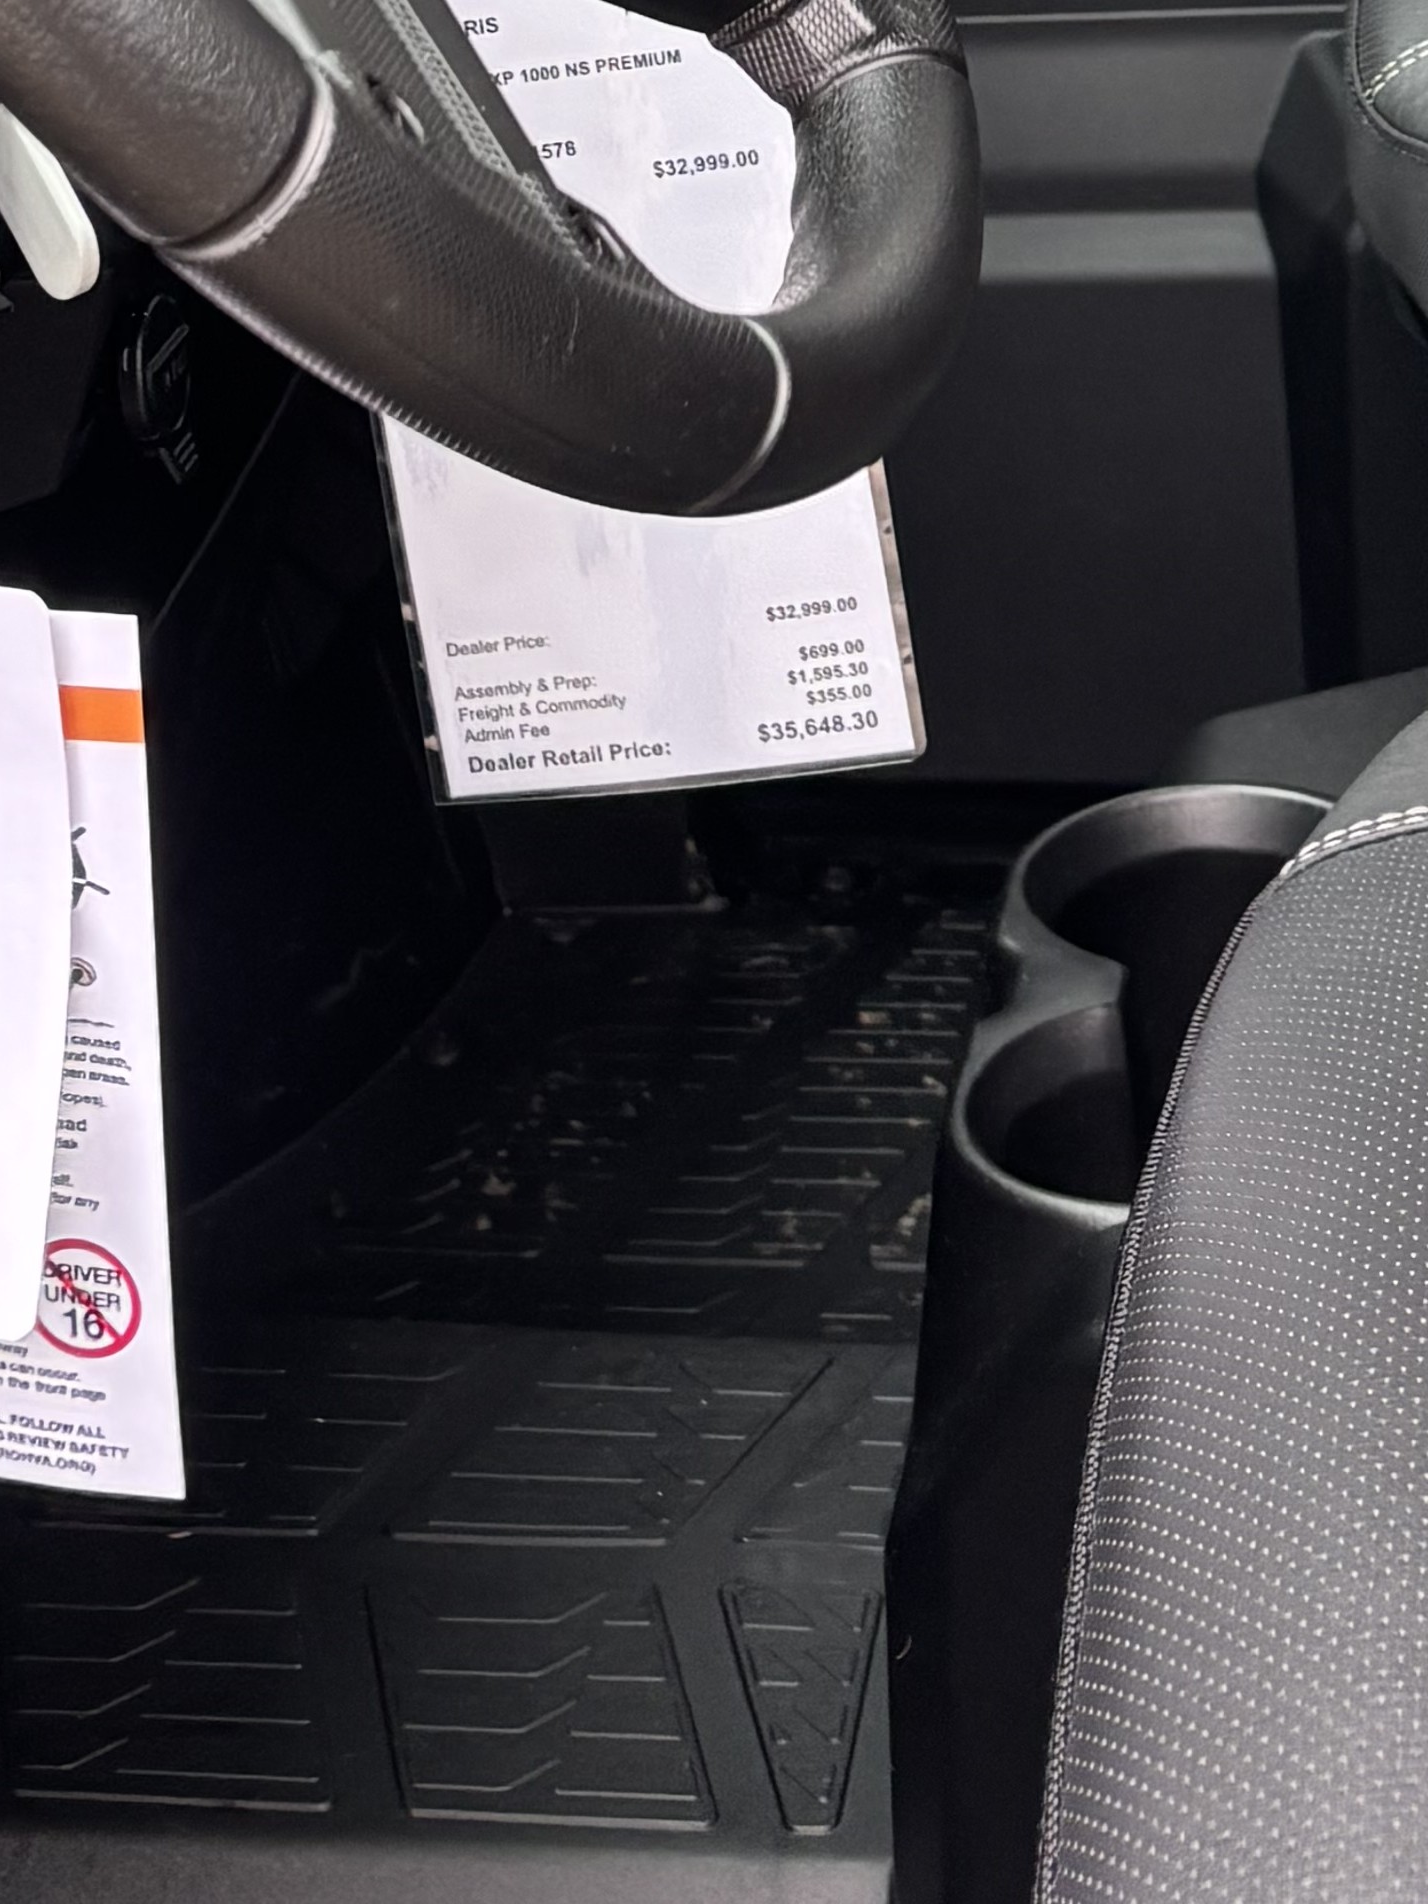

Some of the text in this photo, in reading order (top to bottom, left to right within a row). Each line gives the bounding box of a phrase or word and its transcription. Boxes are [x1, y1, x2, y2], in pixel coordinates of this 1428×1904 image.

[464, 16, 499, 36] RIS
[520, 65, 560, 83] 1000
[565, 61, 591, 77] NS
[595, 48, 683, 75] PREMIUM
[536, 139, 577, 159] 578
[652, 149, 760, 179] $32,999.00
[766, 596, 858, 623] $32,999.00
[446, 634, 551, 658] Dealer Price:
[798, 638, 866, 662] $699.00
[786, 660, 870, 686] $1,595.30
[454, 673, 598, 702] Assembly & Prep:
[806, 683, 873, 706] $355.00
[458, 693, 627, 724] Freight & Commodity
[464, 723, 551, 744] Admin Fee
[757, 709, 880, 744] $35,648.30
[468, 740, 673, 774] Dealer Retail Price:
[42, 1261, 122, 1289] DRIVER
[43, 1284, 122, 1313] UNDER
[62, 1309, 105, 1341] 16
[75, 1424, 106, 1440] ALL
